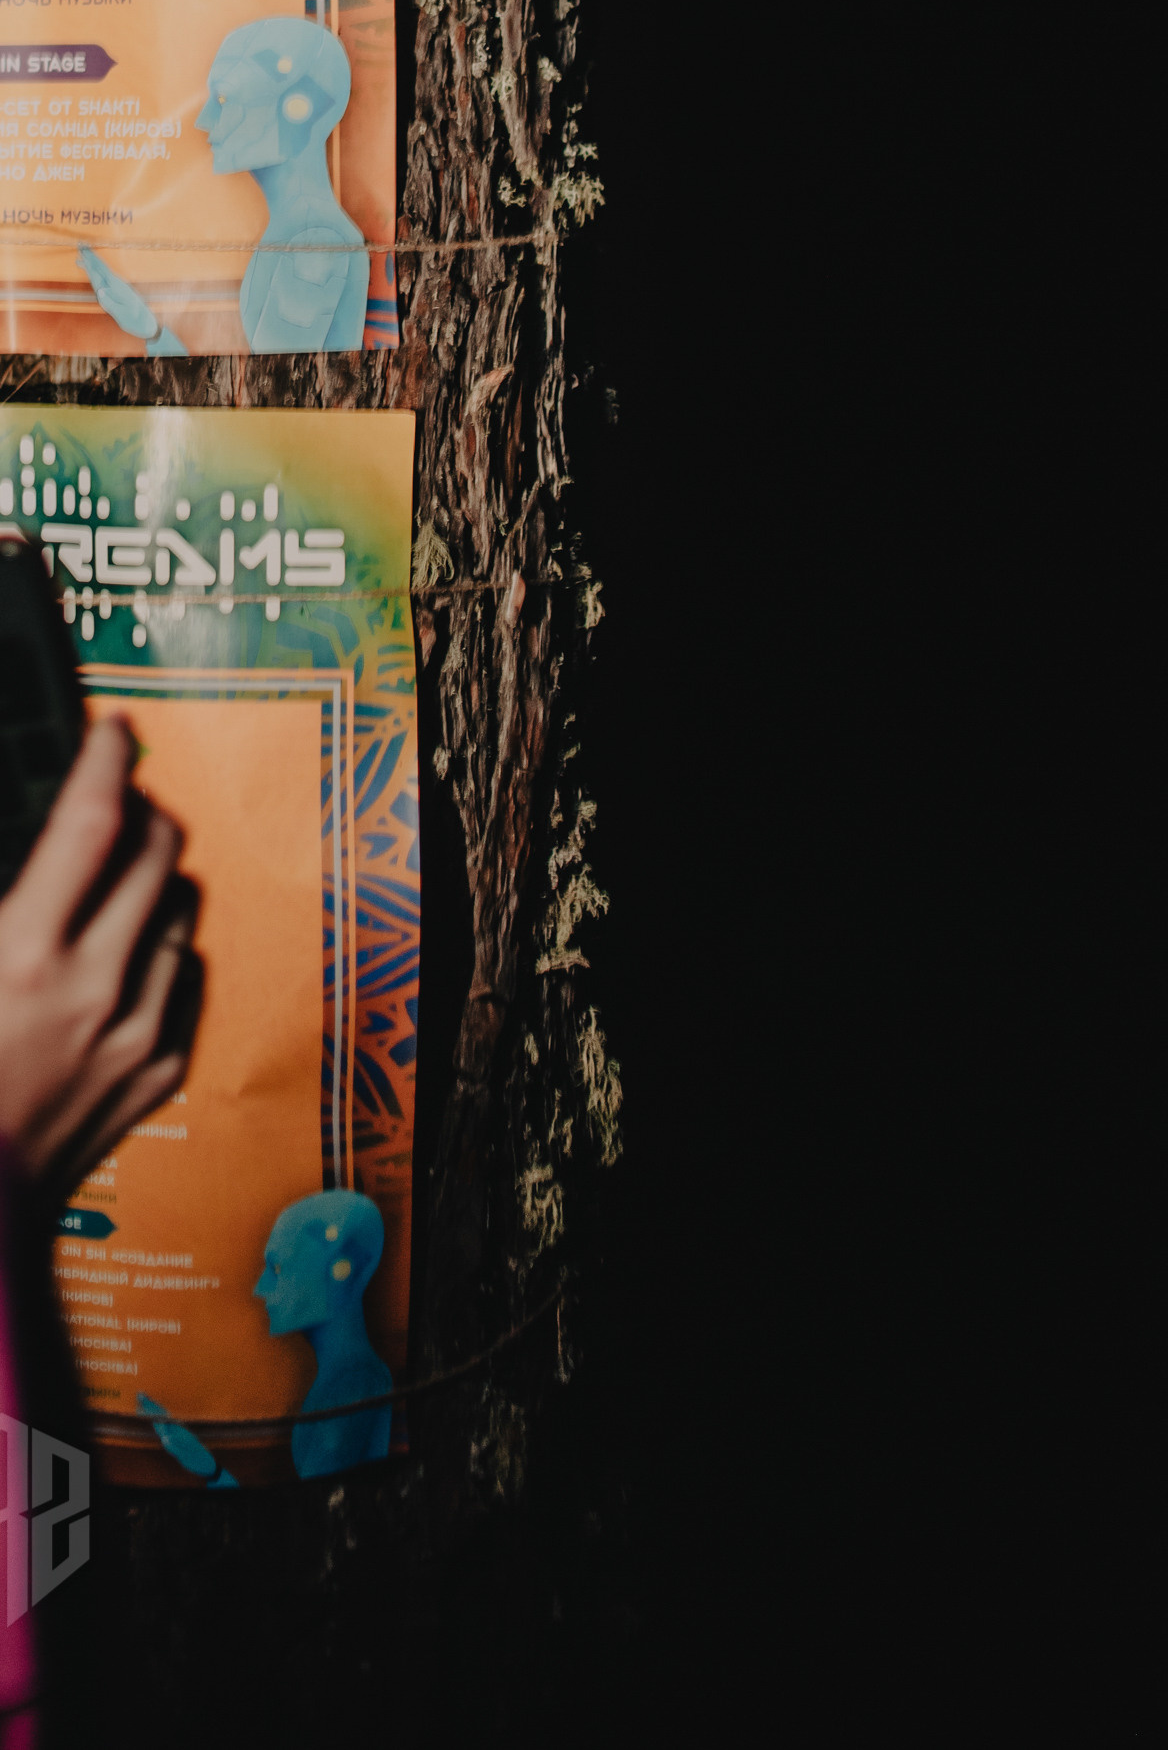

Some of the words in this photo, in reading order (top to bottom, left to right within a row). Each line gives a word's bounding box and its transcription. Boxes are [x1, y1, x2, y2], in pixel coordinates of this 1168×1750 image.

[27, 53, 86, 72] STAGE
[48, 100, 73, 116] ОТ
[78, 98, 140, 116] SHAKTI
[27, 122, 97, 140] СОЛНЦА
[32, 165, 85, 182] ДЖЕМ
[2, 210, 54, 225] НОЧЬ
[60, 210, 133, 225] МУЗЫКИ
